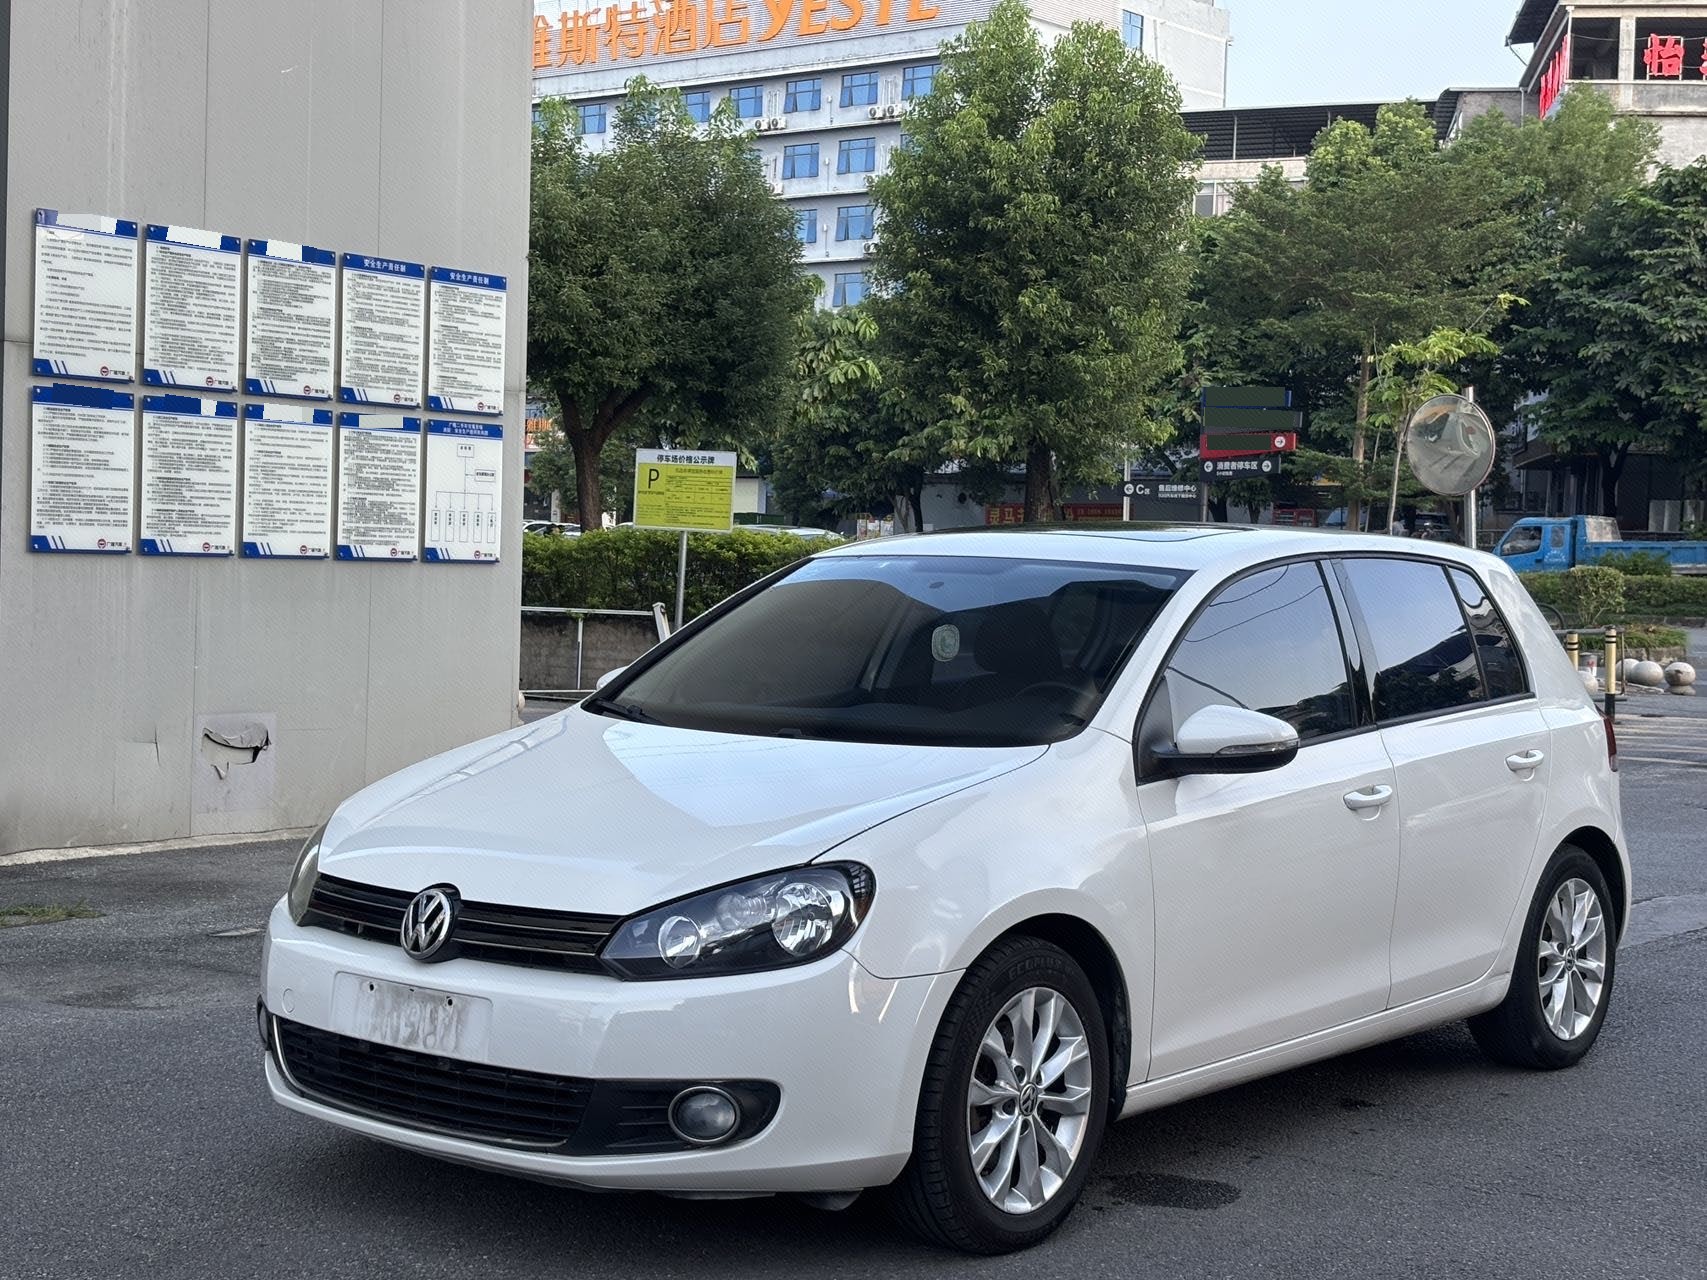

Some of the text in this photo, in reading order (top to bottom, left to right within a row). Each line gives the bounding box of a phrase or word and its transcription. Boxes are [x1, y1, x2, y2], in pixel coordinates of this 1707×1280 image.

[363, 258, 406, 272] 安全生产责任制
[449, 271, 489, 285] 安全生产责任制
[656, 454, 715, 464] 停车场价格公示牌
[648, 468, 660, 489] P
